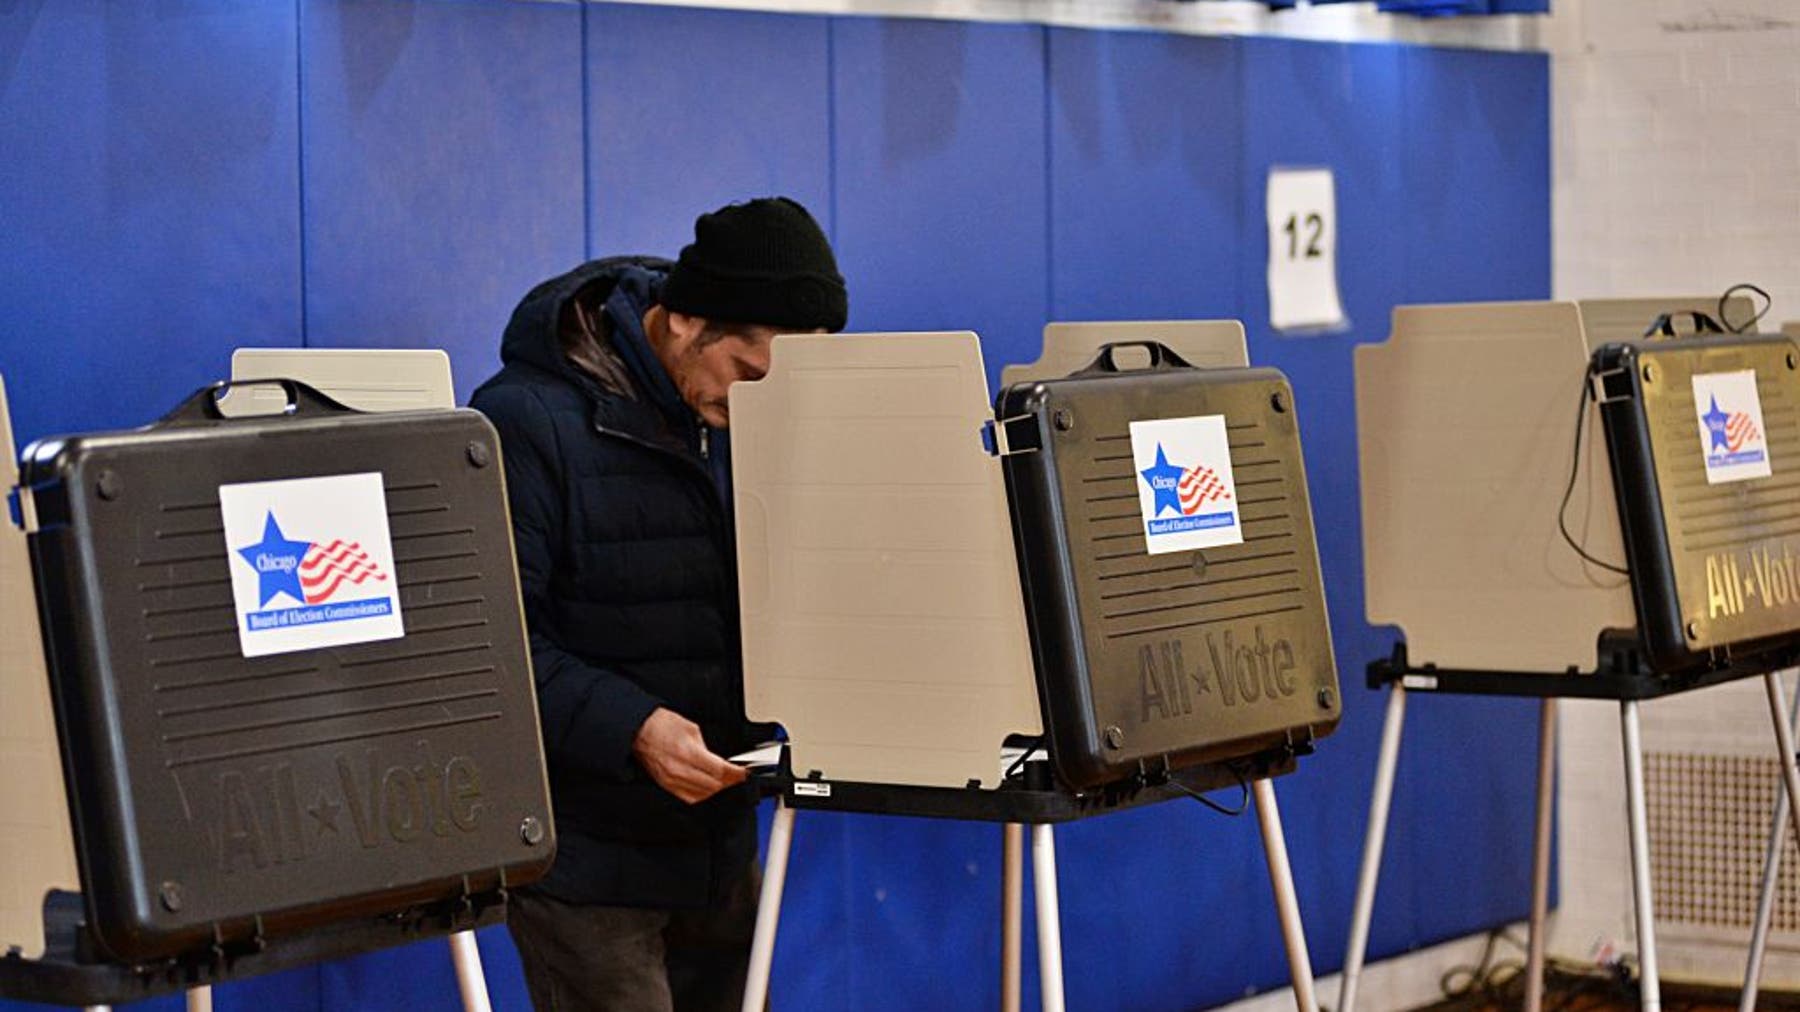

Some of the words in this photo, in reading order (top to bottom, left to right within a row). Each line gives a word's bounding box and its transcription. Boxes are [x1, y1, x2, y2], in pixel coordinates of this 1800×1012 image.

[1285, 212, 1324, 260] 12
[256, 552, 297, 574] Chicago
[1706, 552, 1745, 619] All
[251, 612, 278, 629] Board
[289, 608, 325, 624] Election
[1138, 638, 1193, 723] All
[1205, 625, 1297, 706] Vote
[336, 740, 485, 849] Vote
